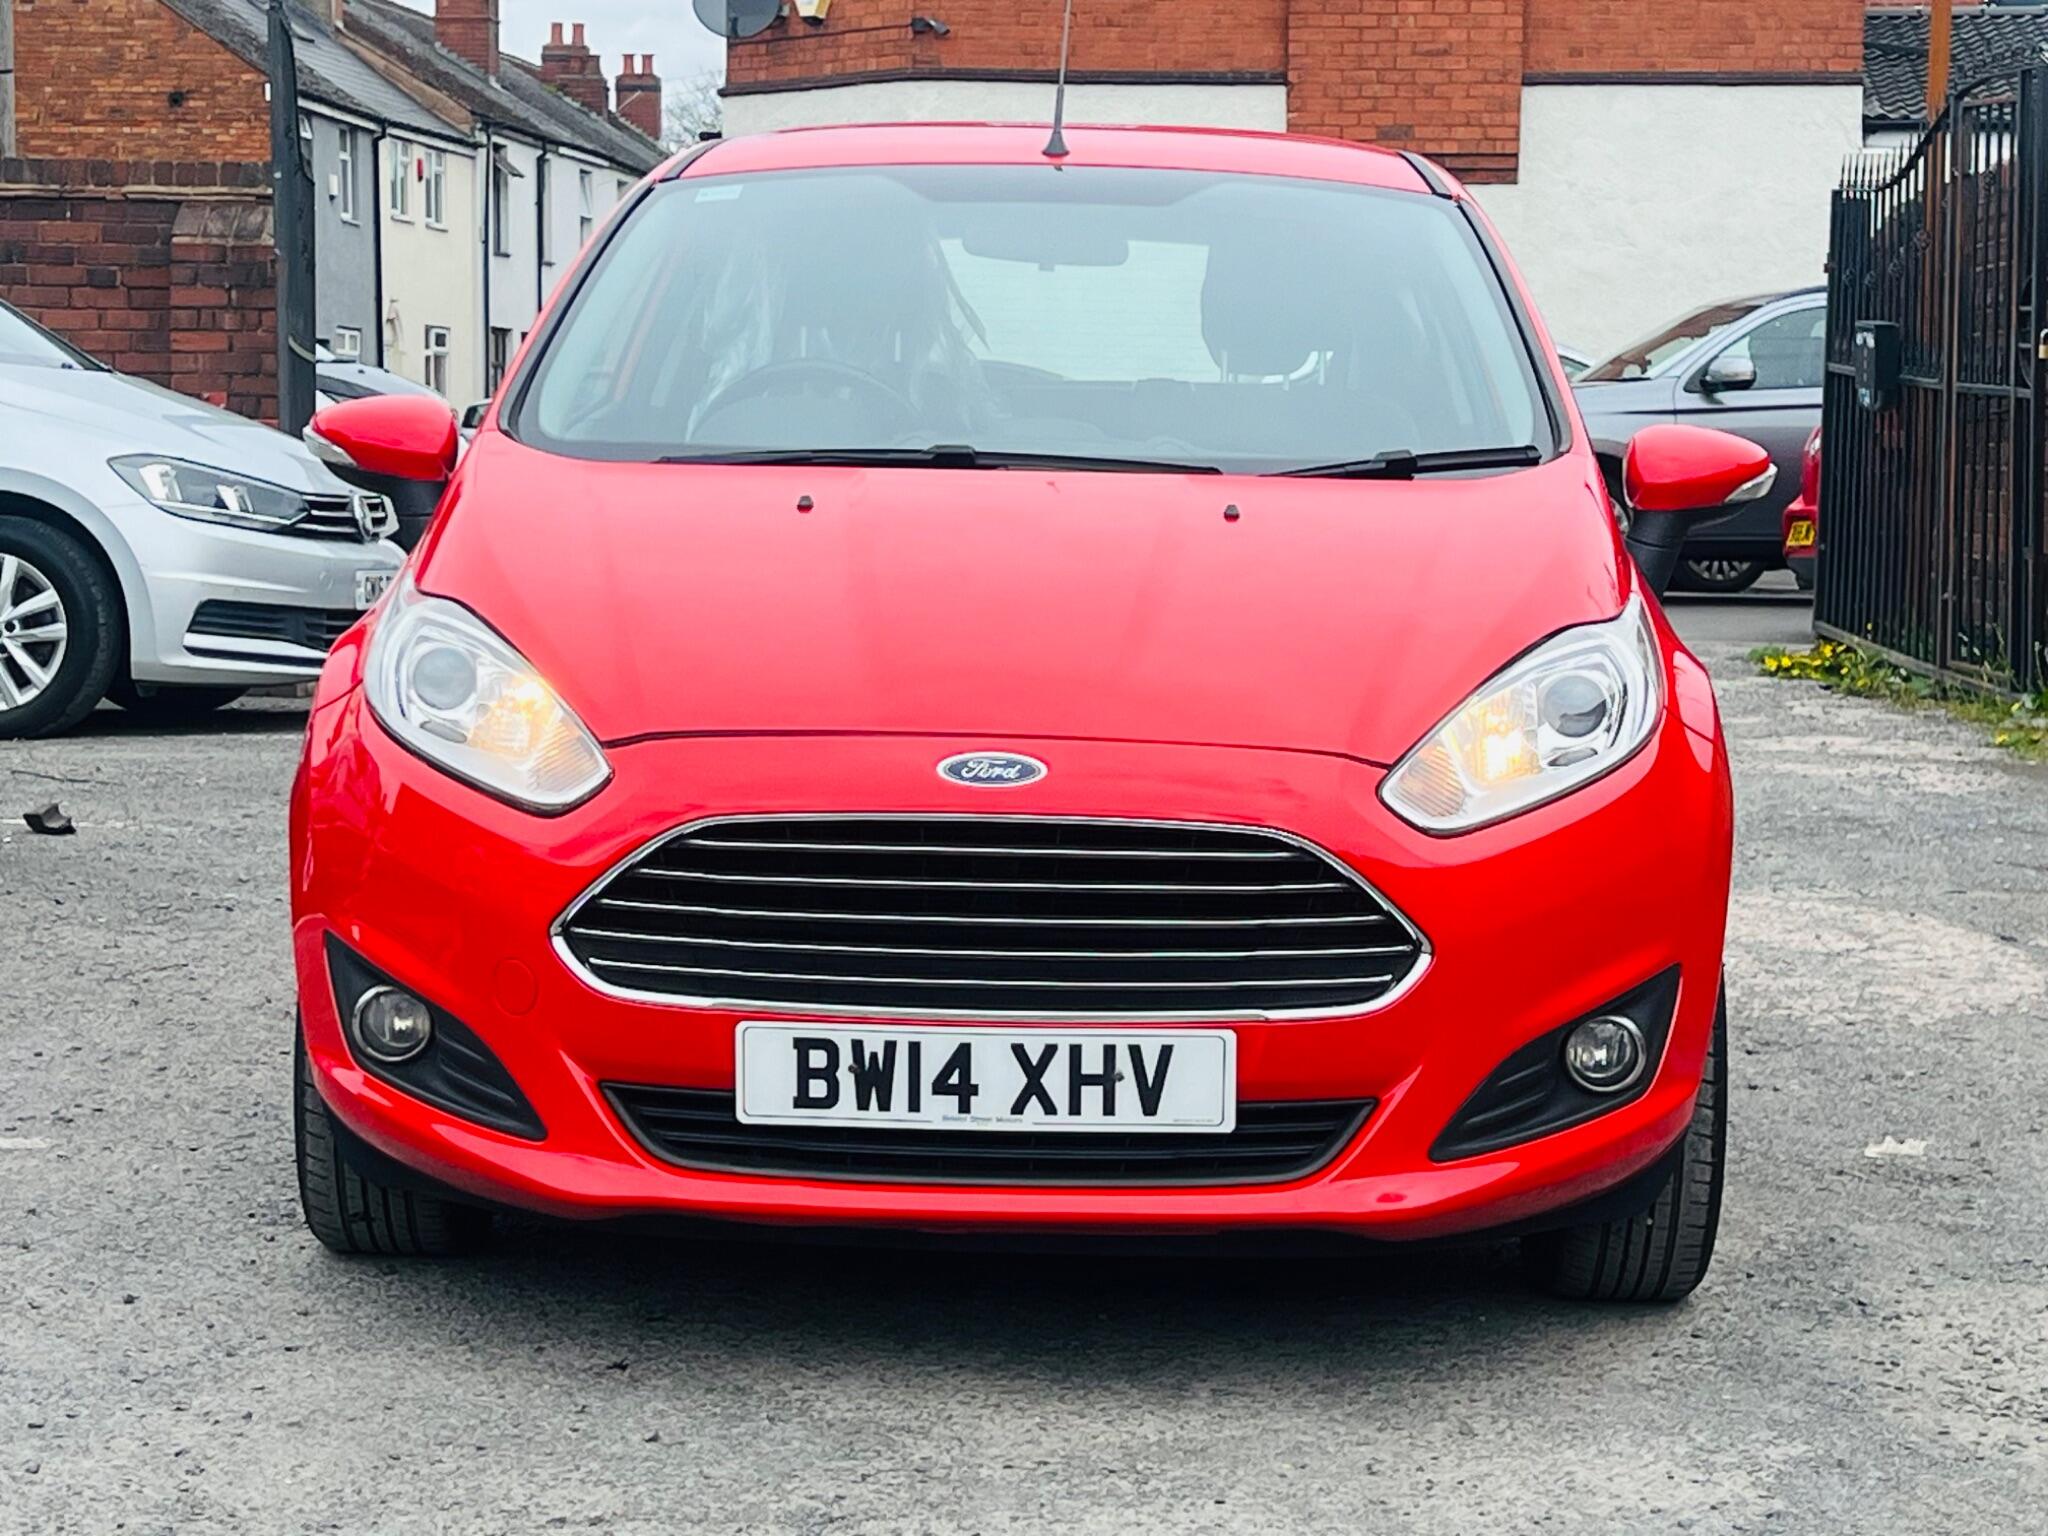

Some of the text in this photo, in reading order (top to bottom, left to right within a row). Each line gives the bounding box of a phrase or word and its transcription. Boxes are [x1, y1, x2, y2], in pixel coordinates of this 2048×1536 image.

[960, 758, 1022, 779] Ford
[792, 1036, 1175, 1117] BW14 XHV
